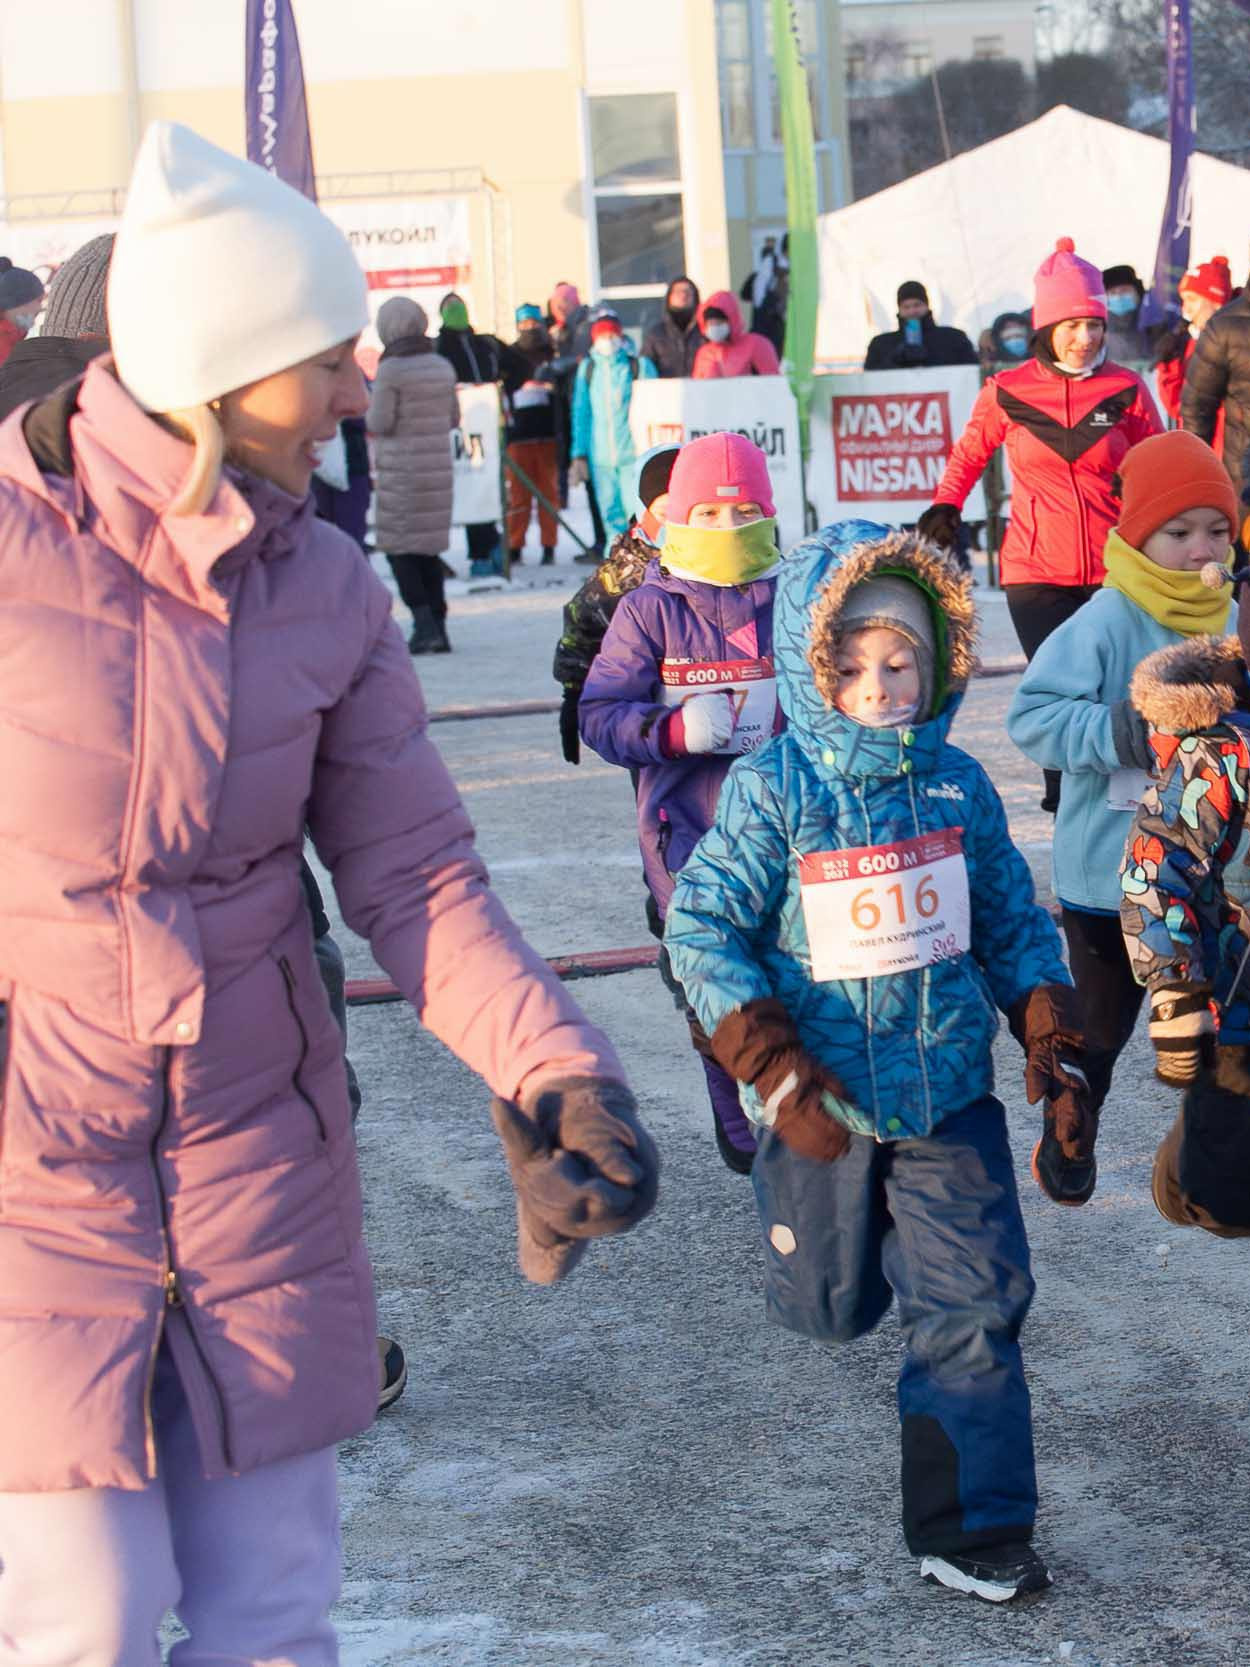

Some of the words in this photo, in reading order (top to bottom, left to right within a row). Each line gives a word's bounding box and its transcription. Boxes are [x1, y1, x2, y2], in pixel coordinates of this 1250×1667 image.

[838, 401, 944, 438] МАРКА
[686, 669, 717, 684] 600
[721, 671, 733, 680] М
[858, 852, 900, 875] 600
[904, 851, 917, 867] М
[850, 874, 940, 931] 616
